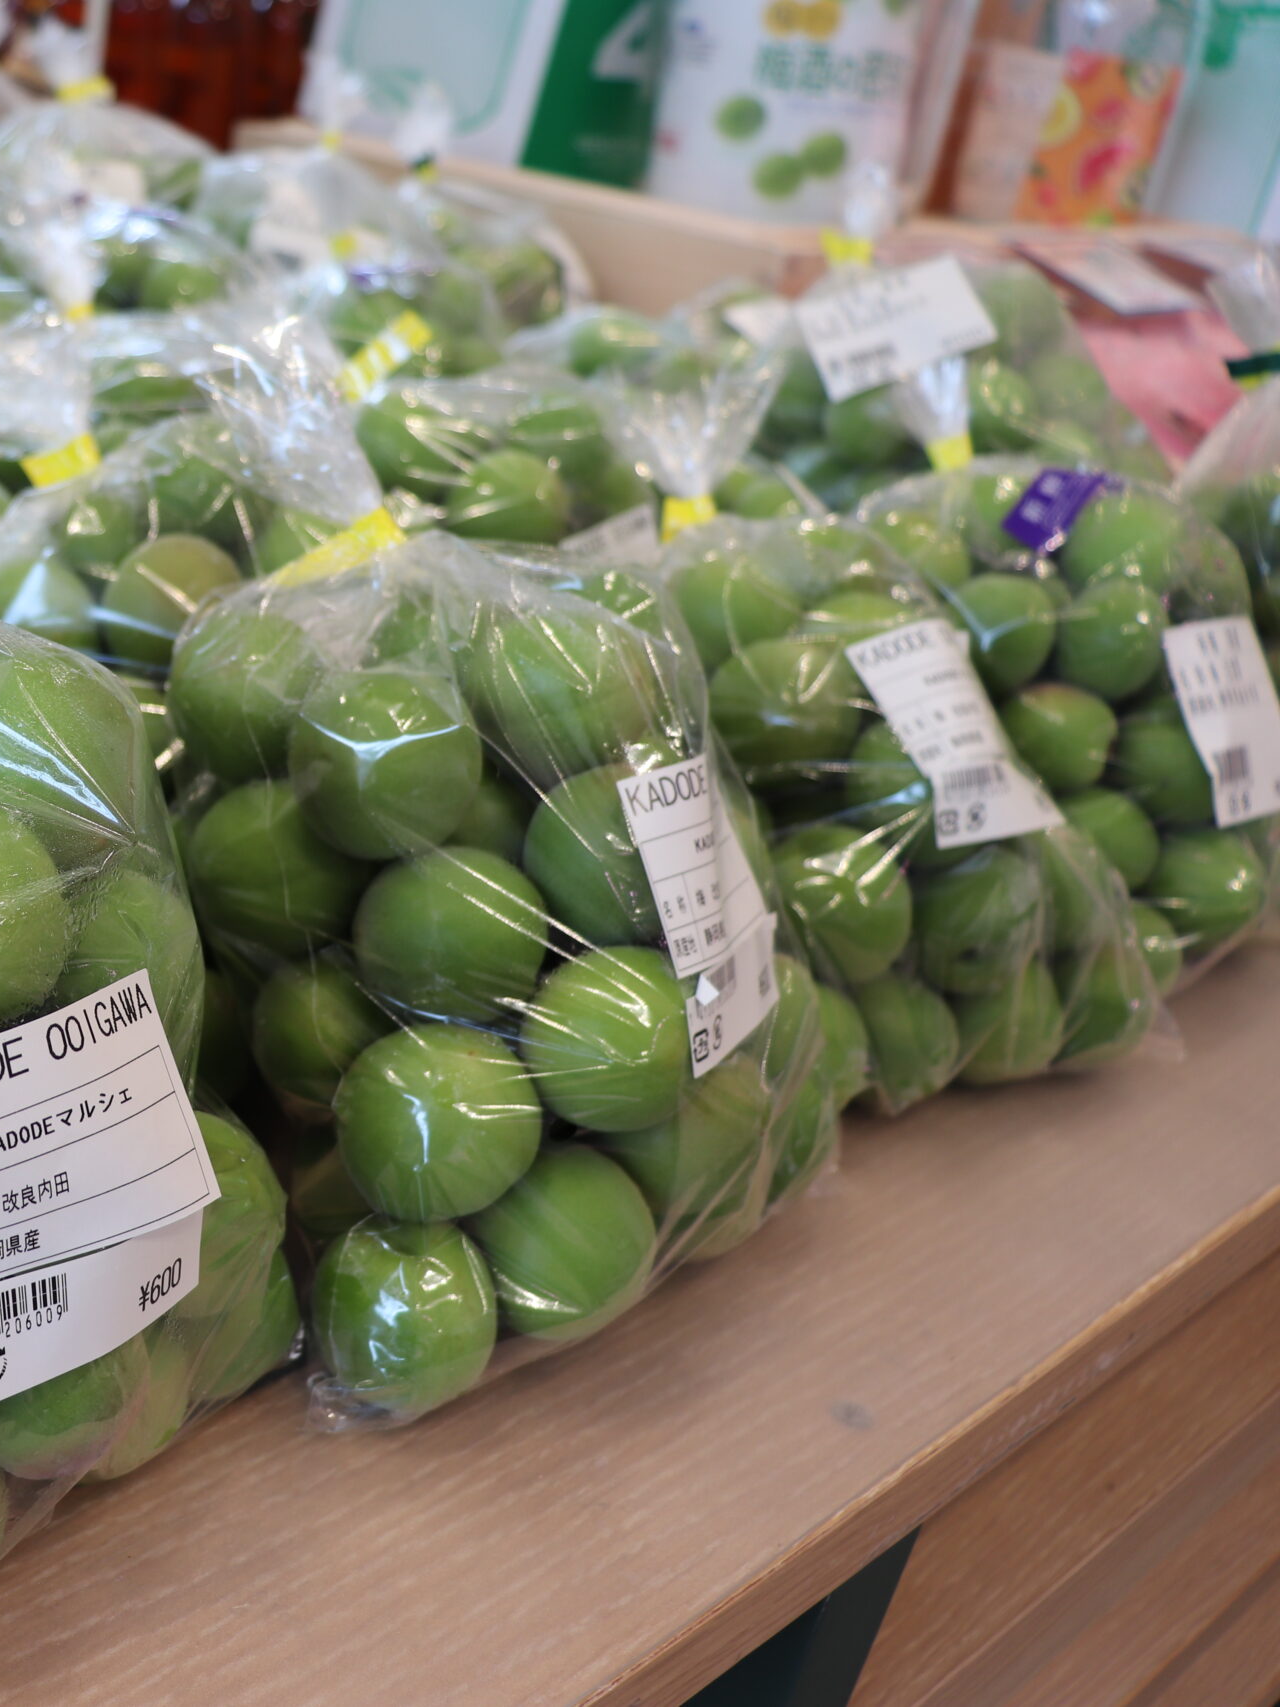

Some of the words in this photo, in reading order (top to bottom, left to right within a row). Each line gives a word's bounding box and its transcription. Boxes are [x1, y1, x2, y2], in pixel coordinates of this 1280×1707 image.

[625, 764, 708, 816] KADODE
[45, 983, 153, 1061] OOIGAWA
[2, 1171, 71, 1214] 改良内田
[138, 1257, 183, 1312] ¥600
